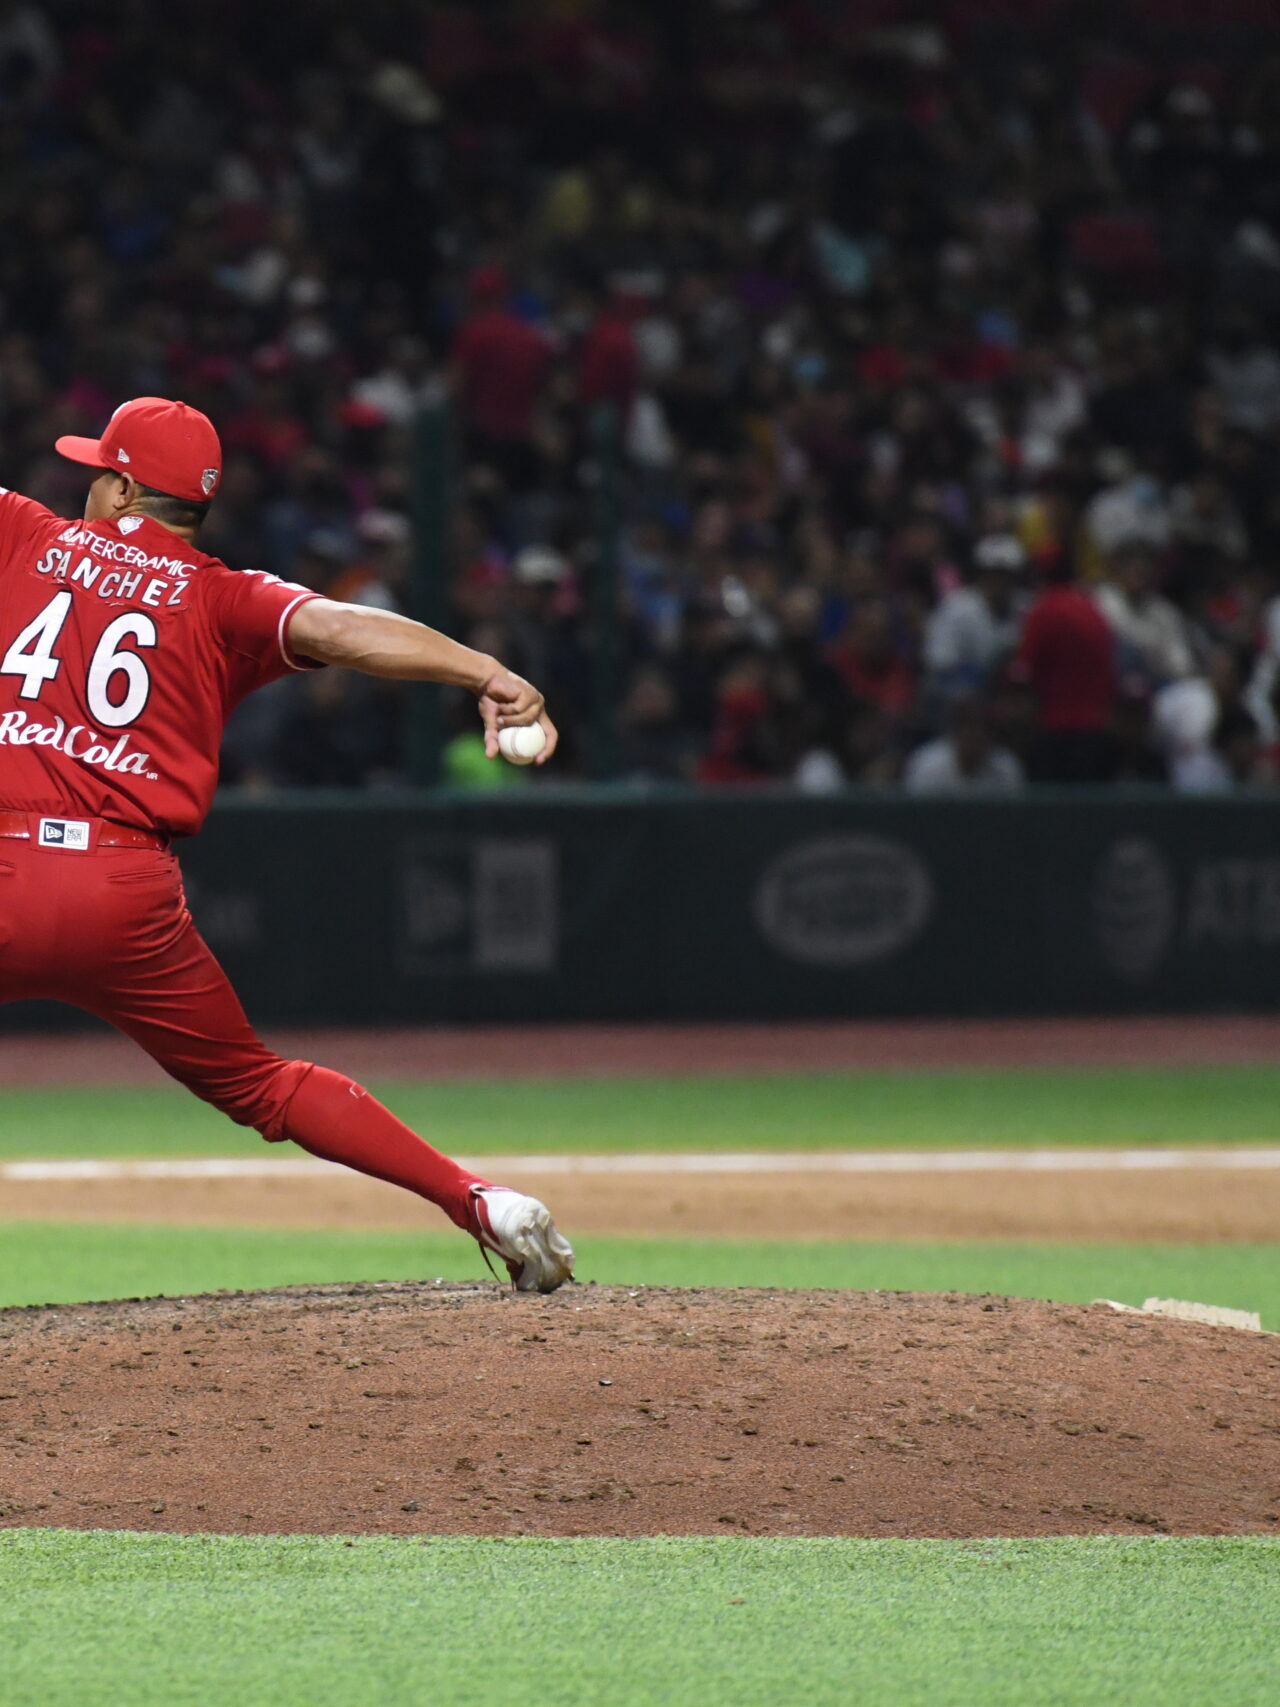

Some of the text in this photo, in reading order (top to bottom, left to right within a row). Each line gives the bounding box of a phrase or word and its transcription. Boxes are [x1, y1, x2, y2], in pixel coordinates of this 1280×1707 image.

[36, 547, 190, 607] SANCHEZ
[66, 528, 197, 577] NTERCERAMIC
[0, 590, 158, 728] 46
